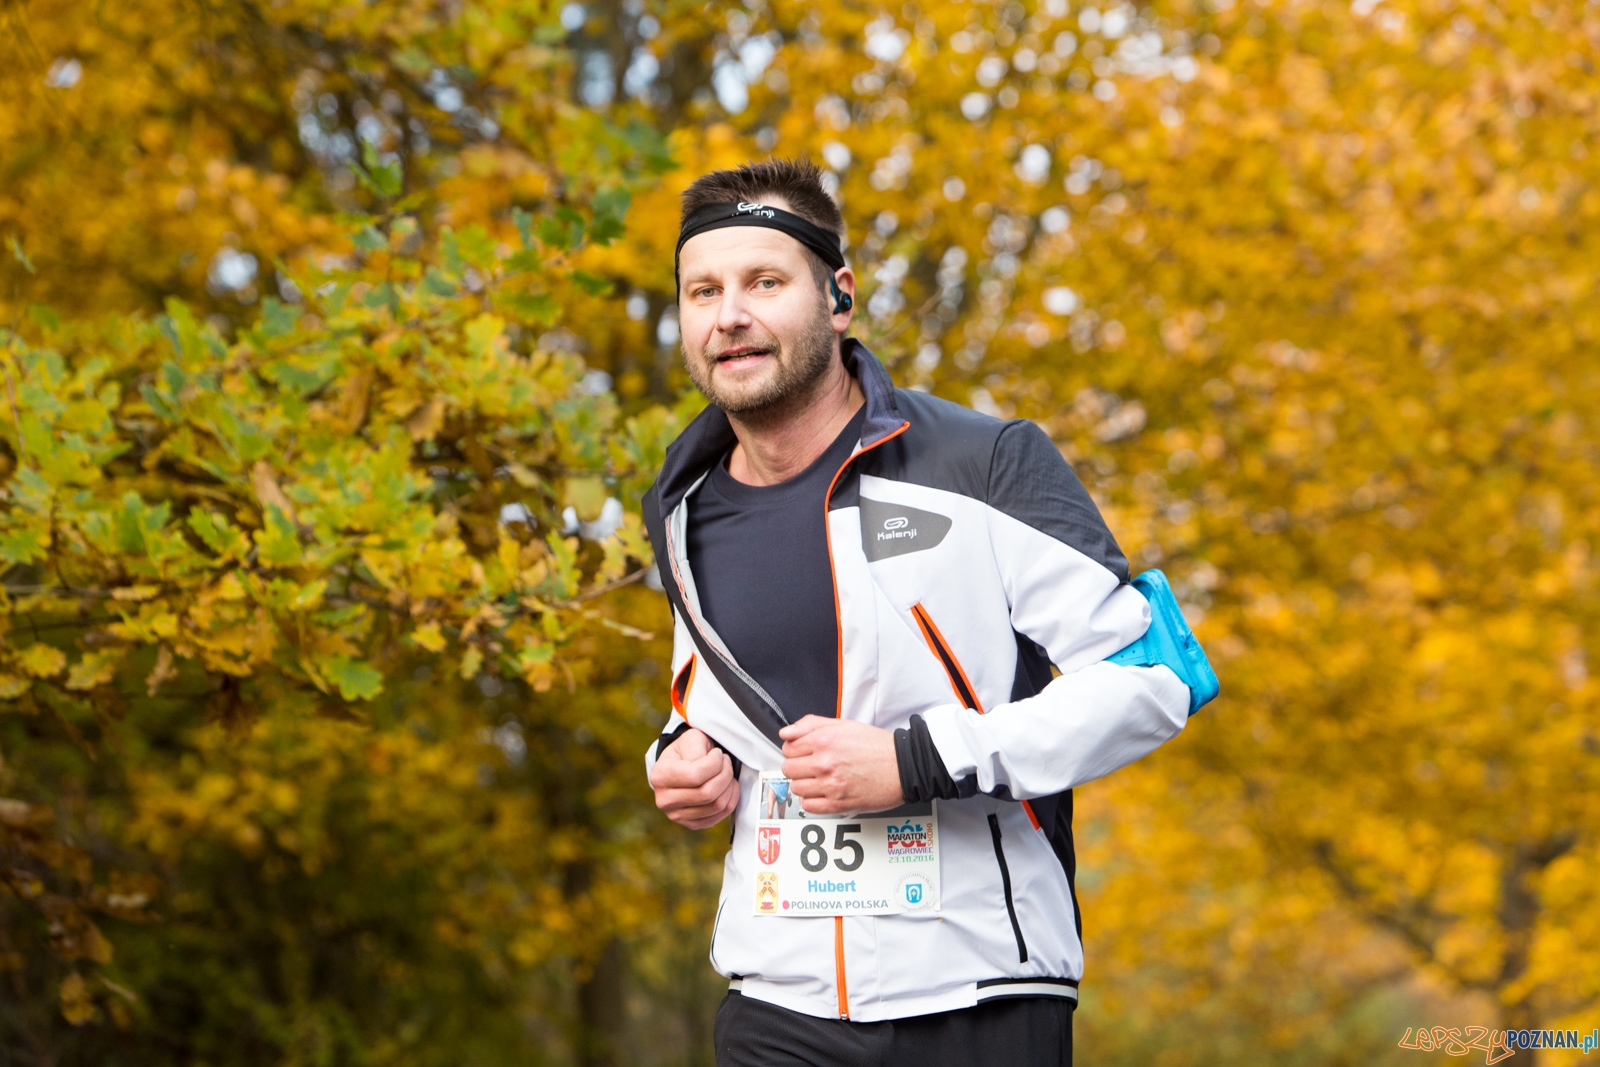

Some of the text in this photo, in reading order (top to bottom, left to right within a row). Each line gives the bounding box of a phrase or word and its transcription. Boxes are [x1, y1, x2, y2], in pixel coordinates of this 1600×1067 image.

[877, 528, 917, 541] Kalenji
[888, 832, 927, 841] MARATON
[800, 823, 865, 873] 85
[887, 847, 934, 857] WĄGROWIEC
[888, 855, 935, 864] 23.10.2016
[807, 880, 857, 893] Hubert
[791, 899, 889, 910] POLINOVA POLSKA
